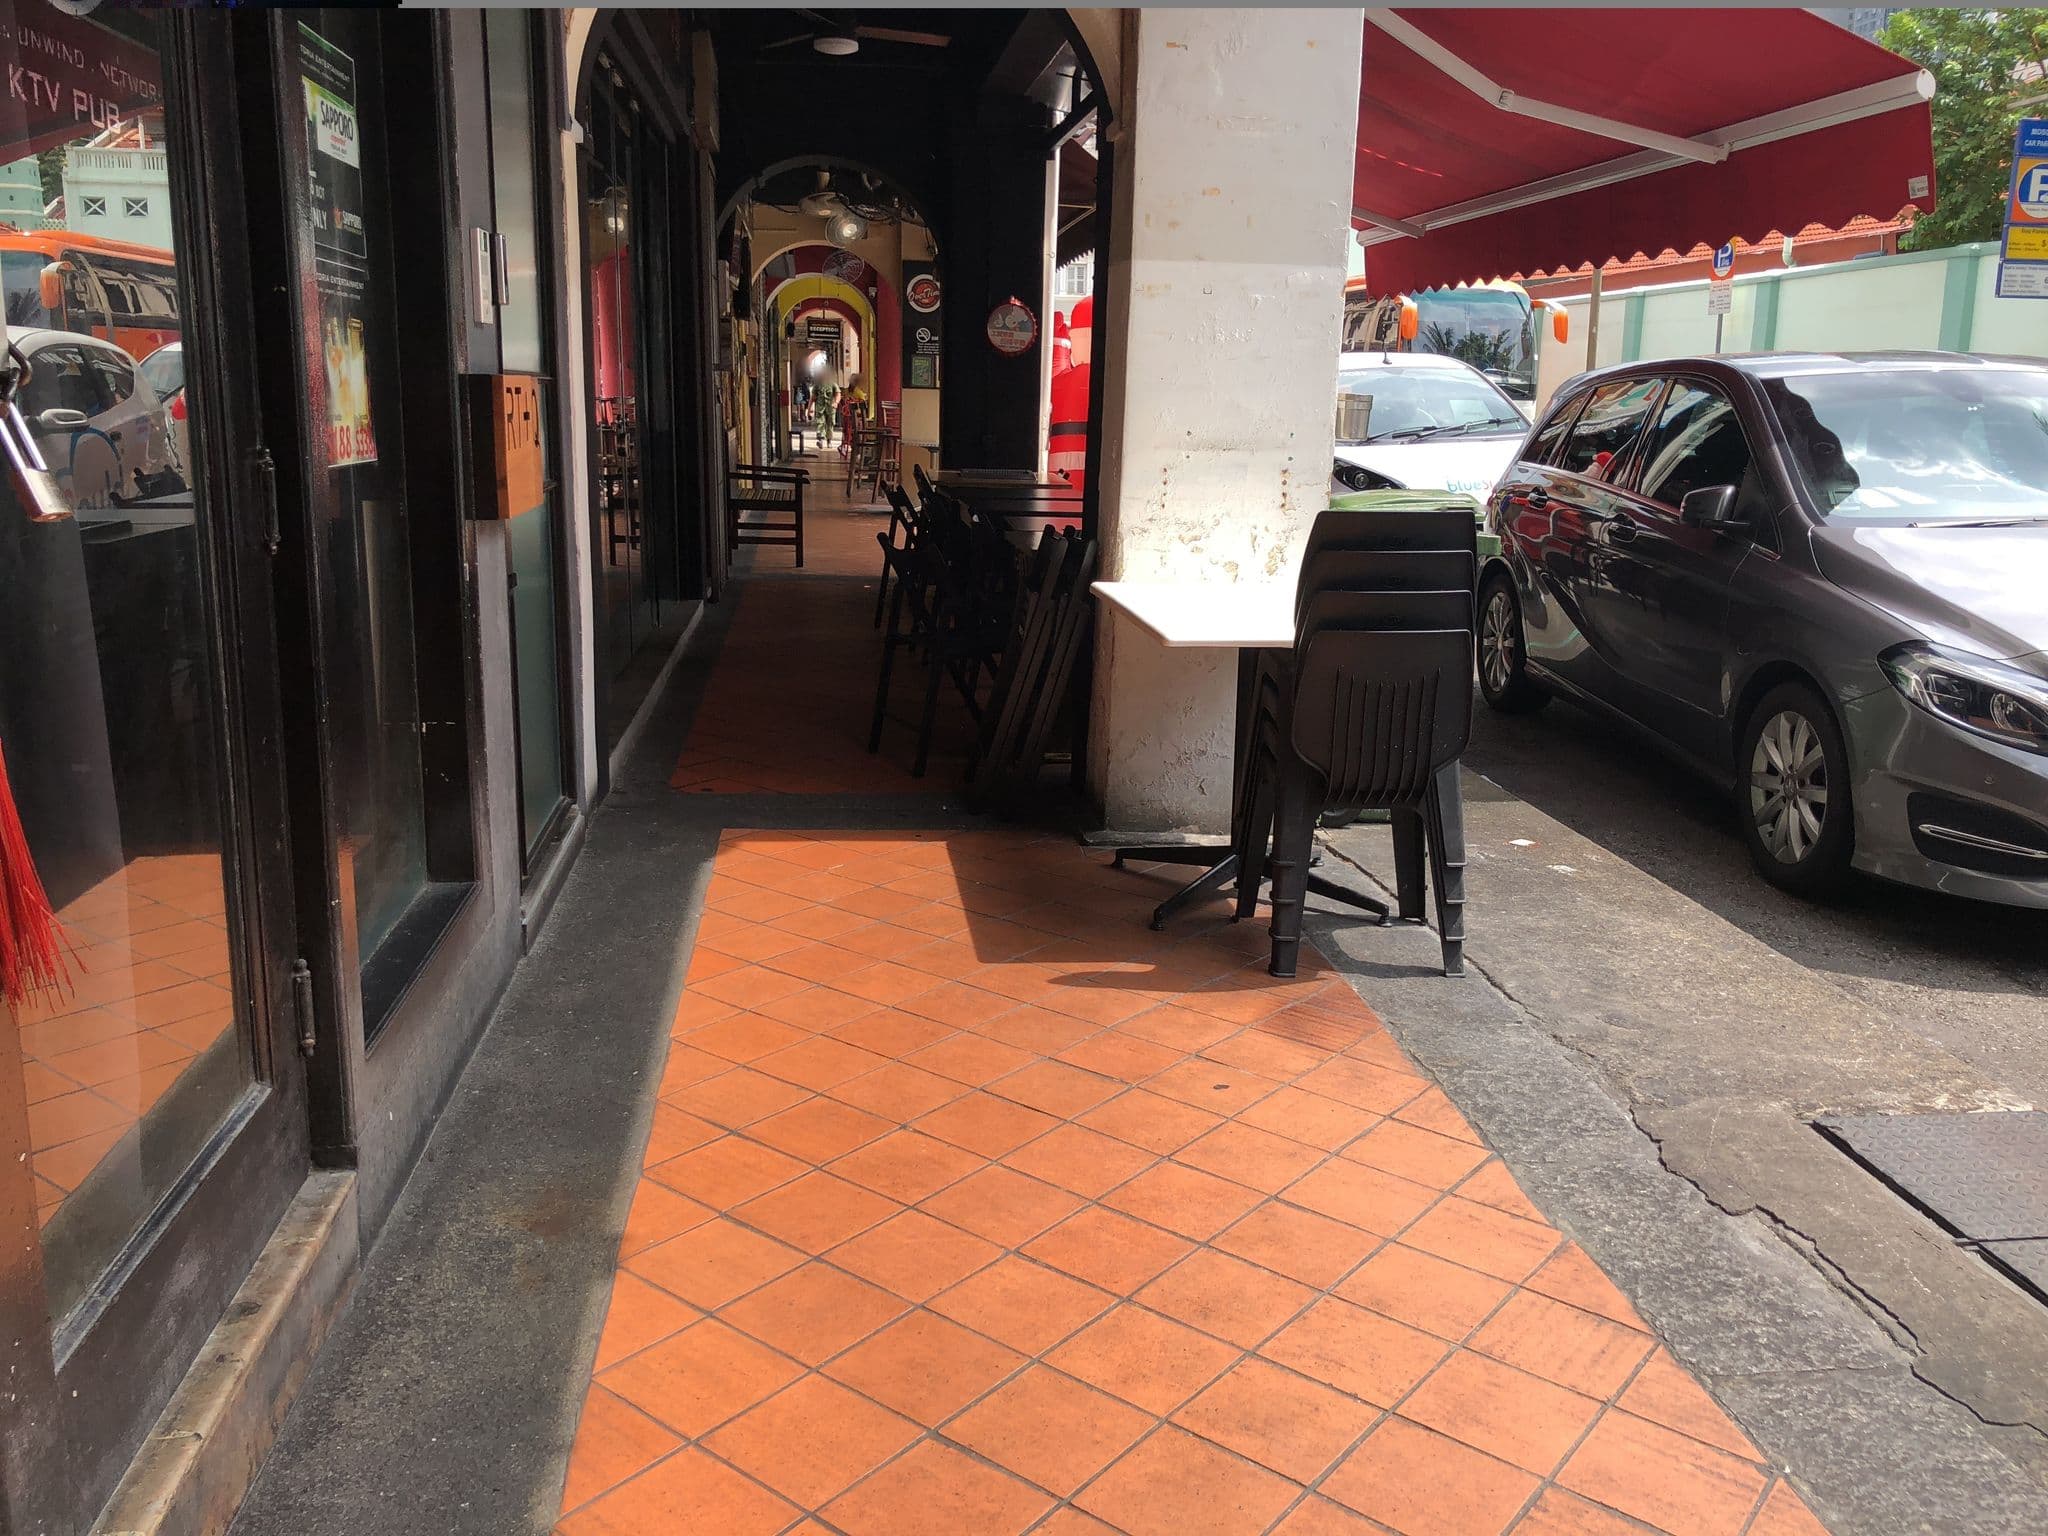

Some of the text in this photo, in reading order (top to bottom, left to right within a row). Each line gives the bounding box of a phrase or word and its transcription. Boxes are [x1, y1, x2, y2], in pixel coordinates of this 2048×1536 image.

[17, 26, 84, 69] UNWIND
[8, 63, 60, 112] KTV
[99, 58, 162, 103] NETWOR
[72, 88, 121, 134] PUB
[320, 100, 354, 142] SAPPORO
[1717, 242, 1732, 268] P
